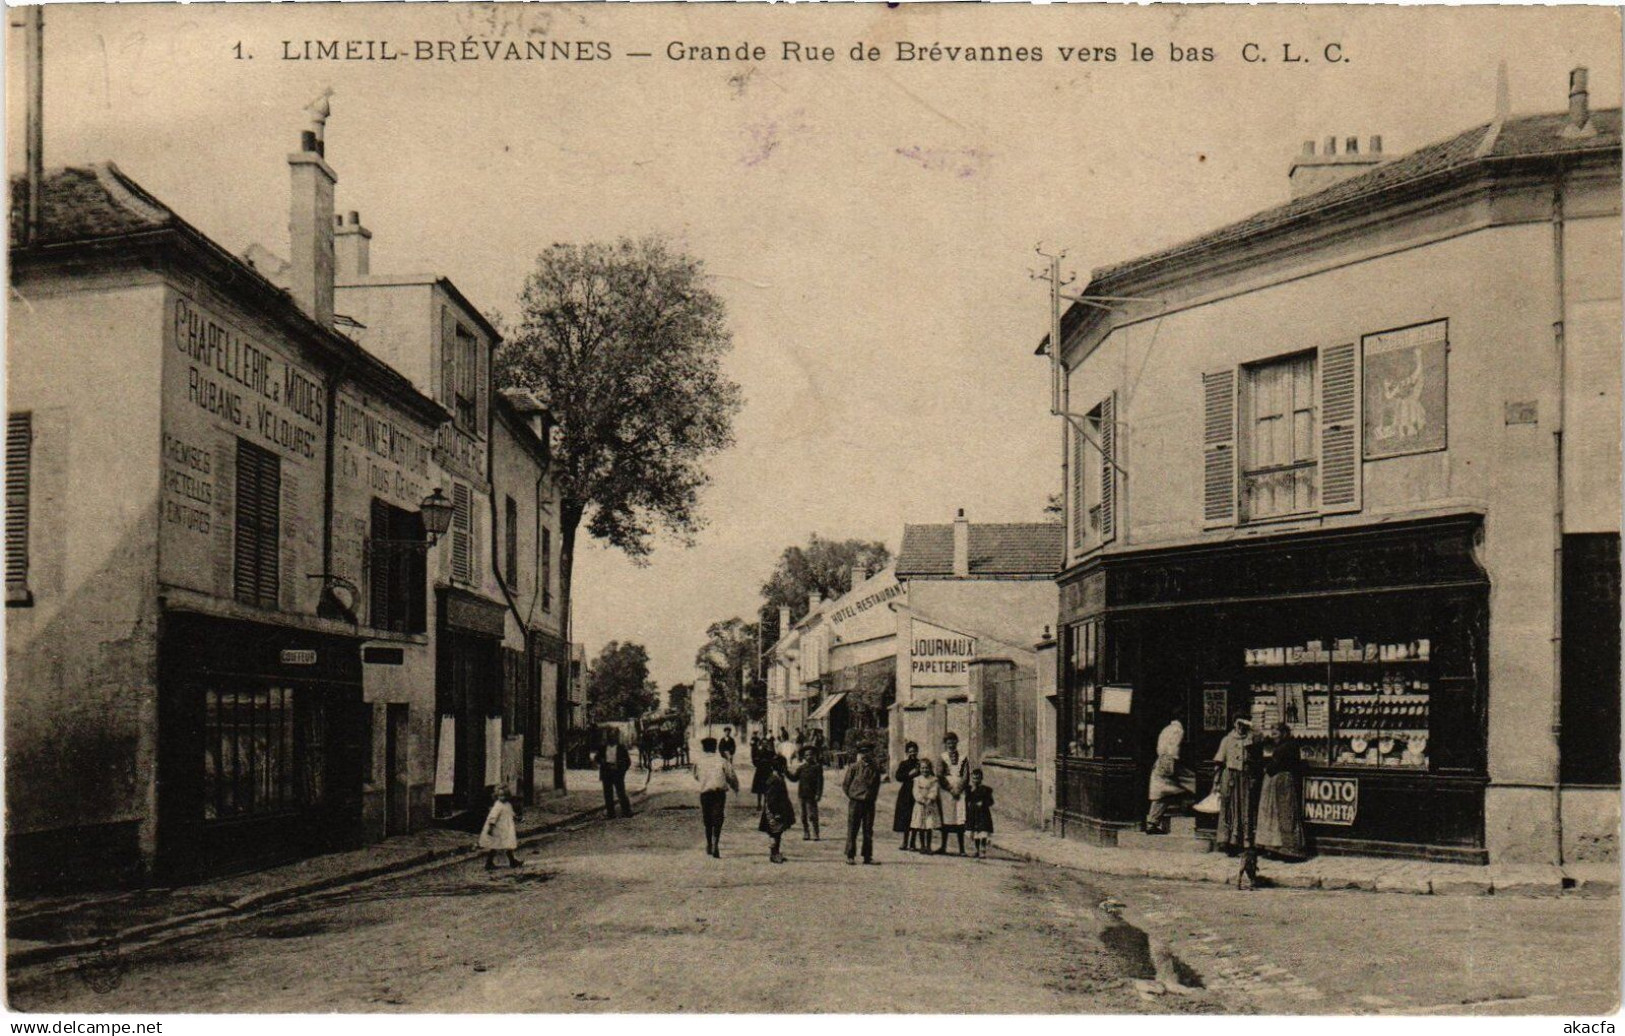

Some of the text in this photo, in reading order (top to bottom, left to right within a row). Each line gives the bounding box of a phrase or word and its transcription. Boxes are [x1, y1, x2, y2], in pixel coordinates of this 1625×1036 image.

[175, 299, 271, 399] CHAPELLERIE
[284, 363, 322, 427] MODES
[189, 366, 241, 425] RUBANS
[366, 456, 389, 494] TOUS
[911, 639, 973, 656] JOURNAUX
[912, 660, 967, 673] PAPETERIE
[1305, 780, 1355, 802] MOTO
[1305, 803, 1354, 820] NAPHTA
